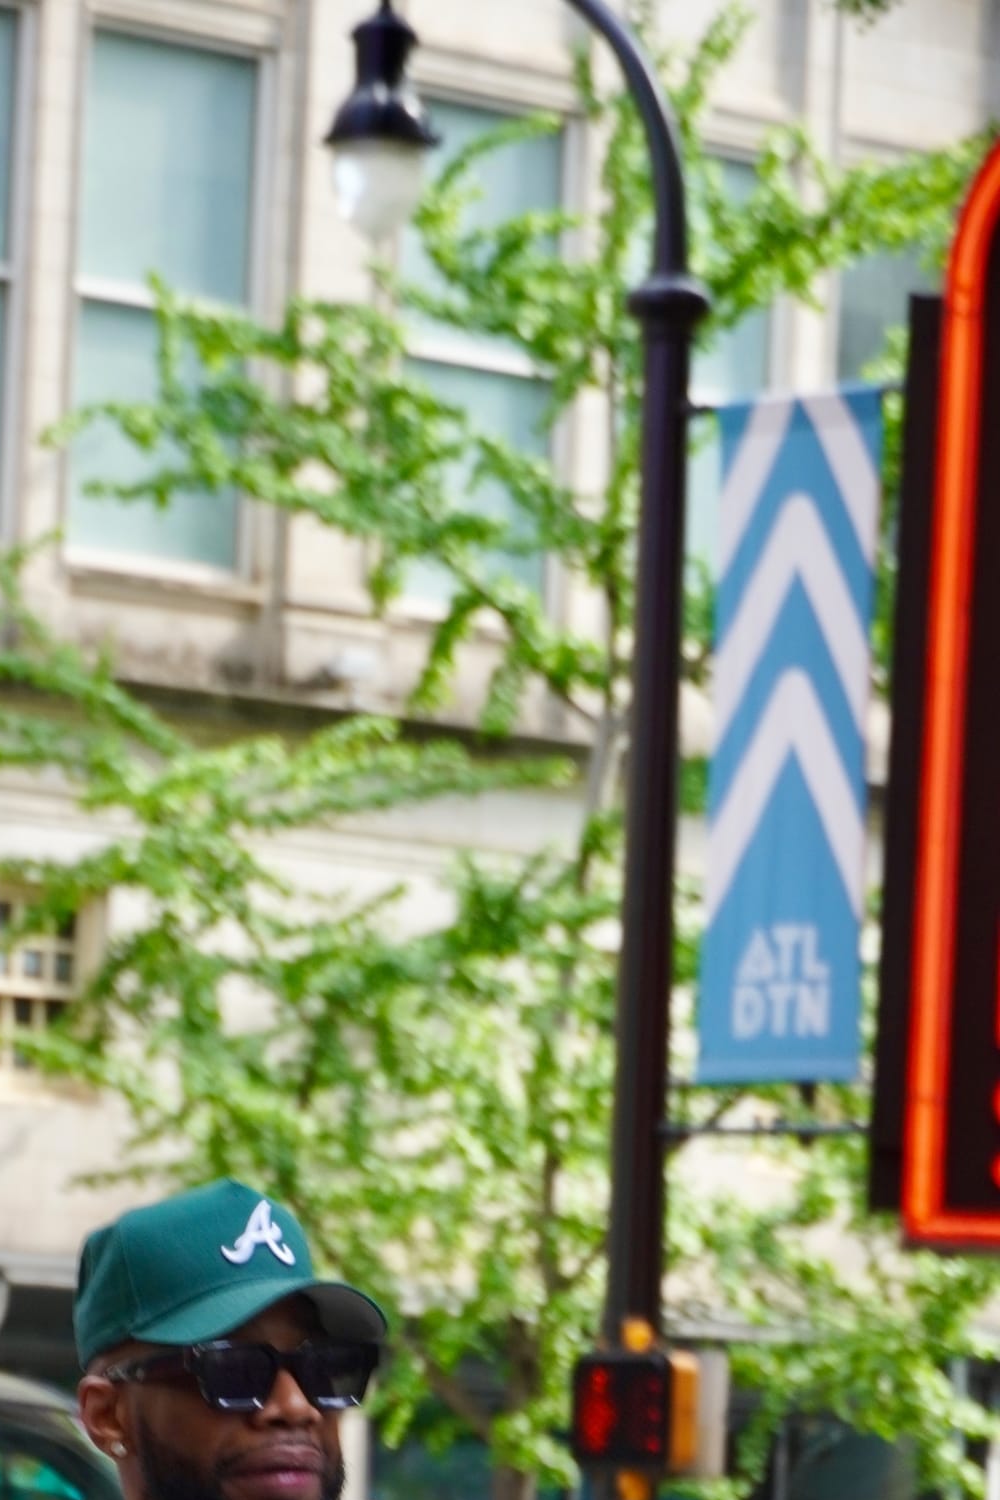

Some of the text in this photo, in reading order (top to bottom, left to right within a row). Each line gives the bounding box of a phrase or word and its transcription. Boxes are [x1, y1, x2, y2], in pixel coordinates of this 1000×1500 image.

[735, 921, 830, 980] ATL
[732, 980, 830, 1039] DTN
[221, 1200, 296, 1266] A
